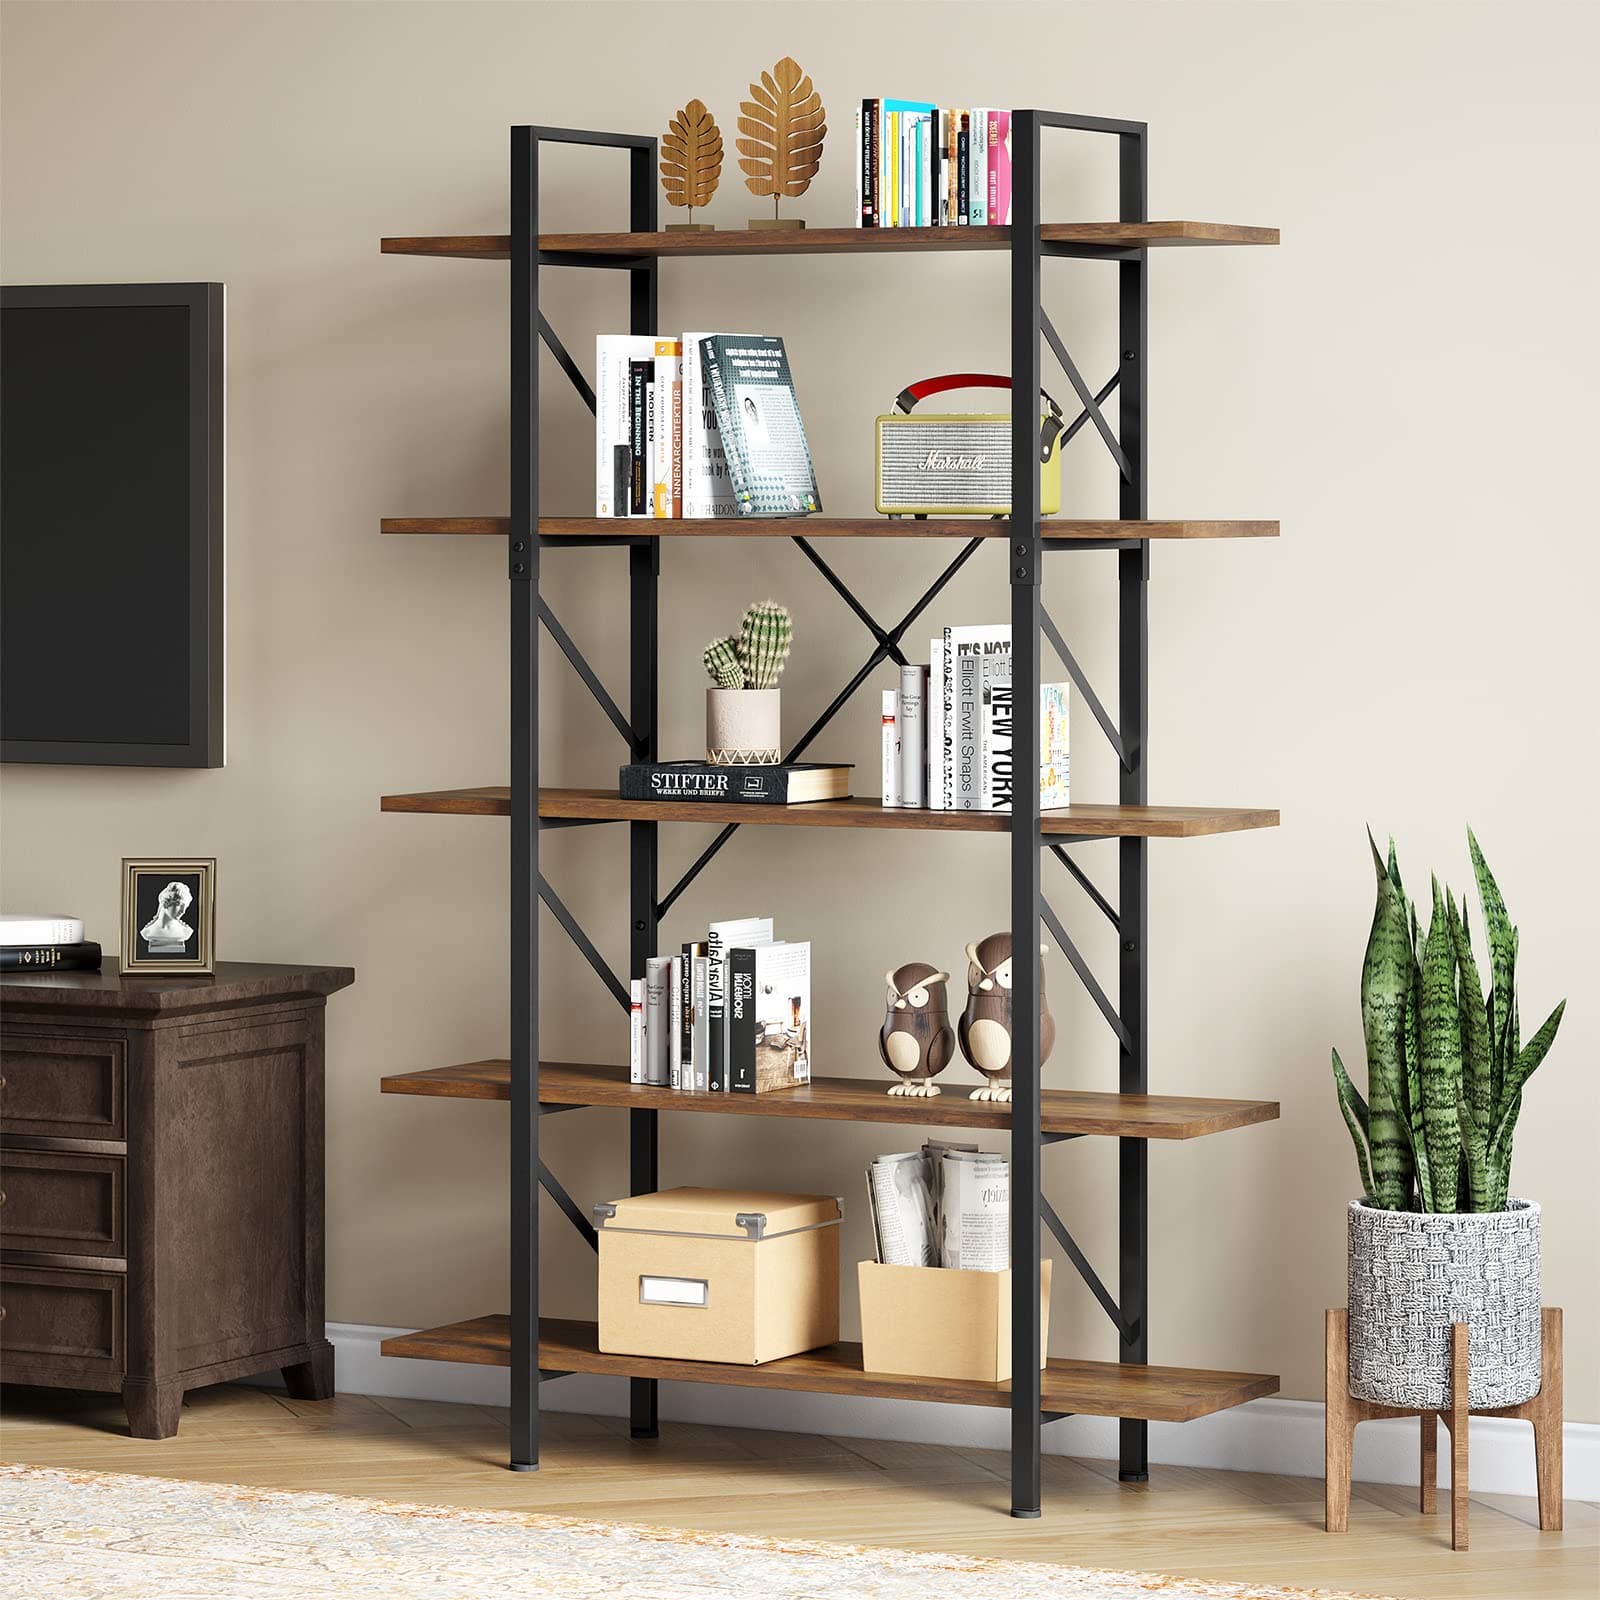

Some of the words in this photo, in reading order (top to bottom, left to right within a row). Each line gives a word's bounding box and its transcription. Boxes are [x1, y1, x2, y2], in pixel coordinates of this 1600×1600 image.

[635, 375, 642, 386] IN
[673, 389, 681, 499] INNENARCHITEKTUR
[918, 449, 987, 471] Marshall
[958, 642, 980, 657] IT'S
[983, 641, 1011, 655] NOT
[961, 659, 974, 697] Elliott
[961, 701, 974, 741] Erwitt
[992, 687, 1012, 737] NEW
[651, 773, 729, 790] STIFTER
[960, 745, 974, 792] Snaps
[991, 747, 1012, 808] YORK
[699, 789, 725, 797] BRIEFE
